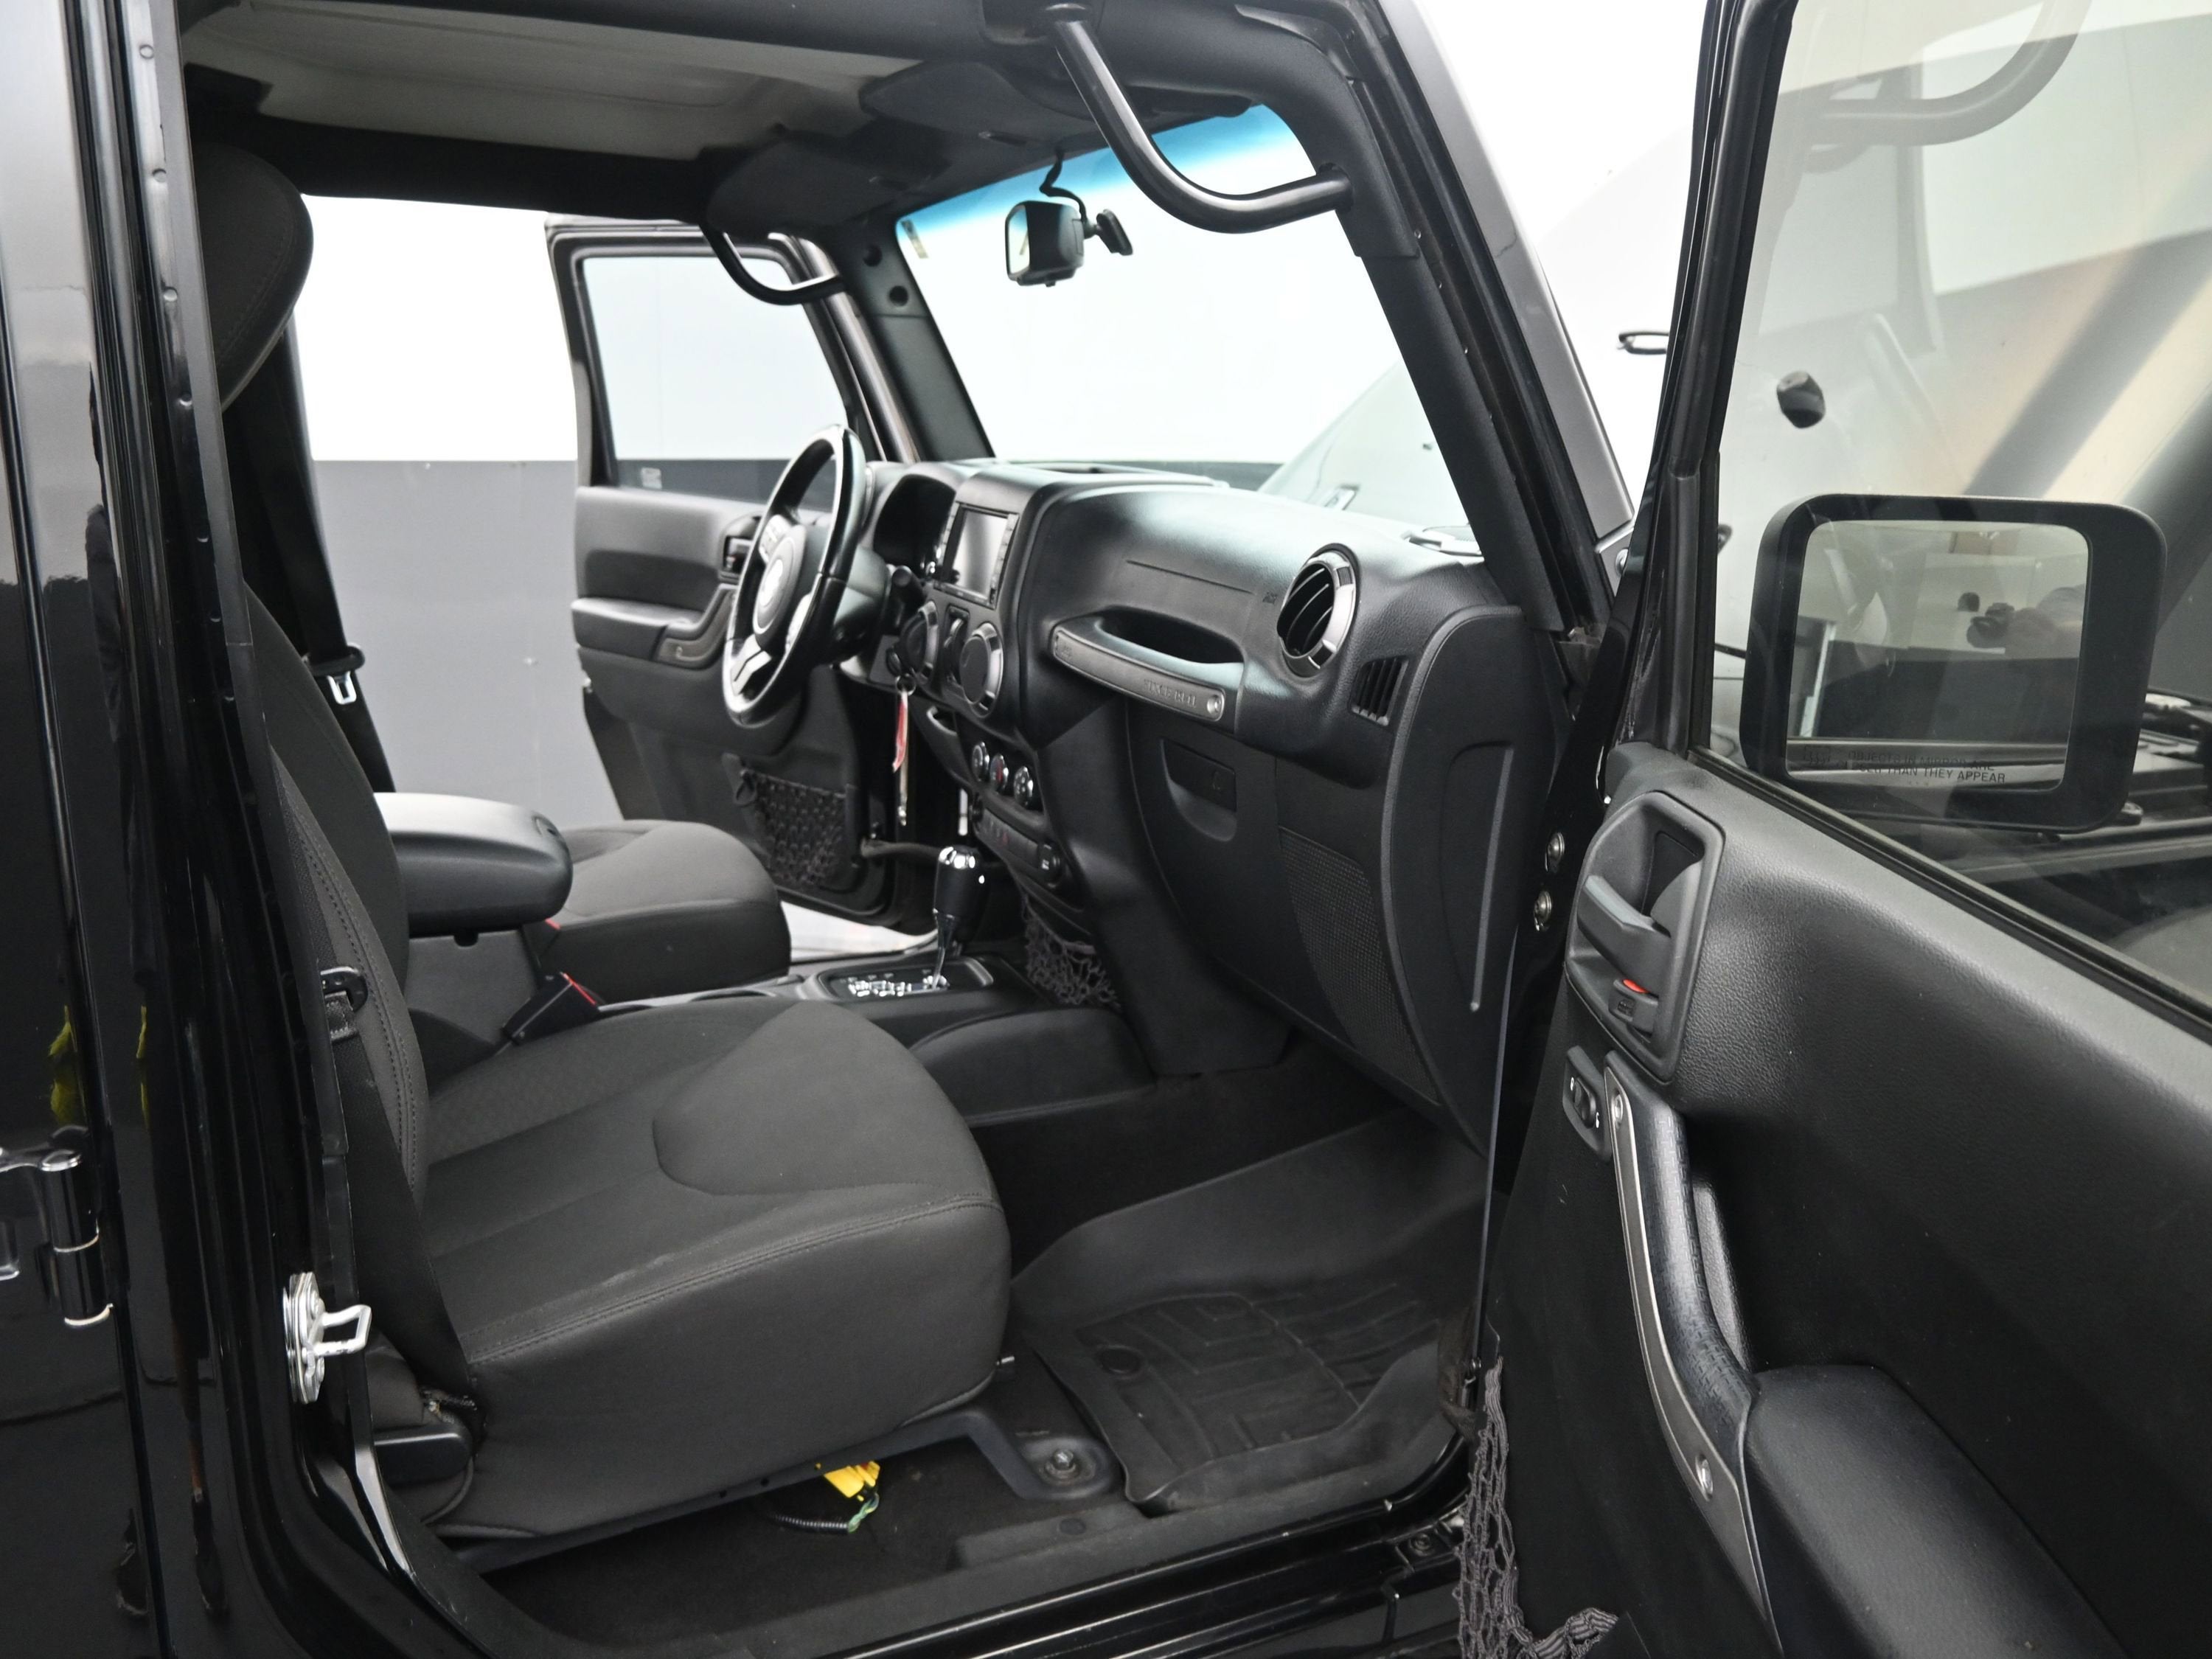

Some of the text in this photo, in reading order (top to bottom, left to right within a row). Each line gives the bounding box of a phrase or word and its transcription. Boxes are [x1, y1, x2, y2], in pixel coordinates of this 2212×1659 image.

[1848, 751, 1901, 764] OBJECTS
[1905, 754, 1916, 765] IN
[1924, 768, 1953, 779] THEY
[1958, 771, 2006, 783] APPEAR
